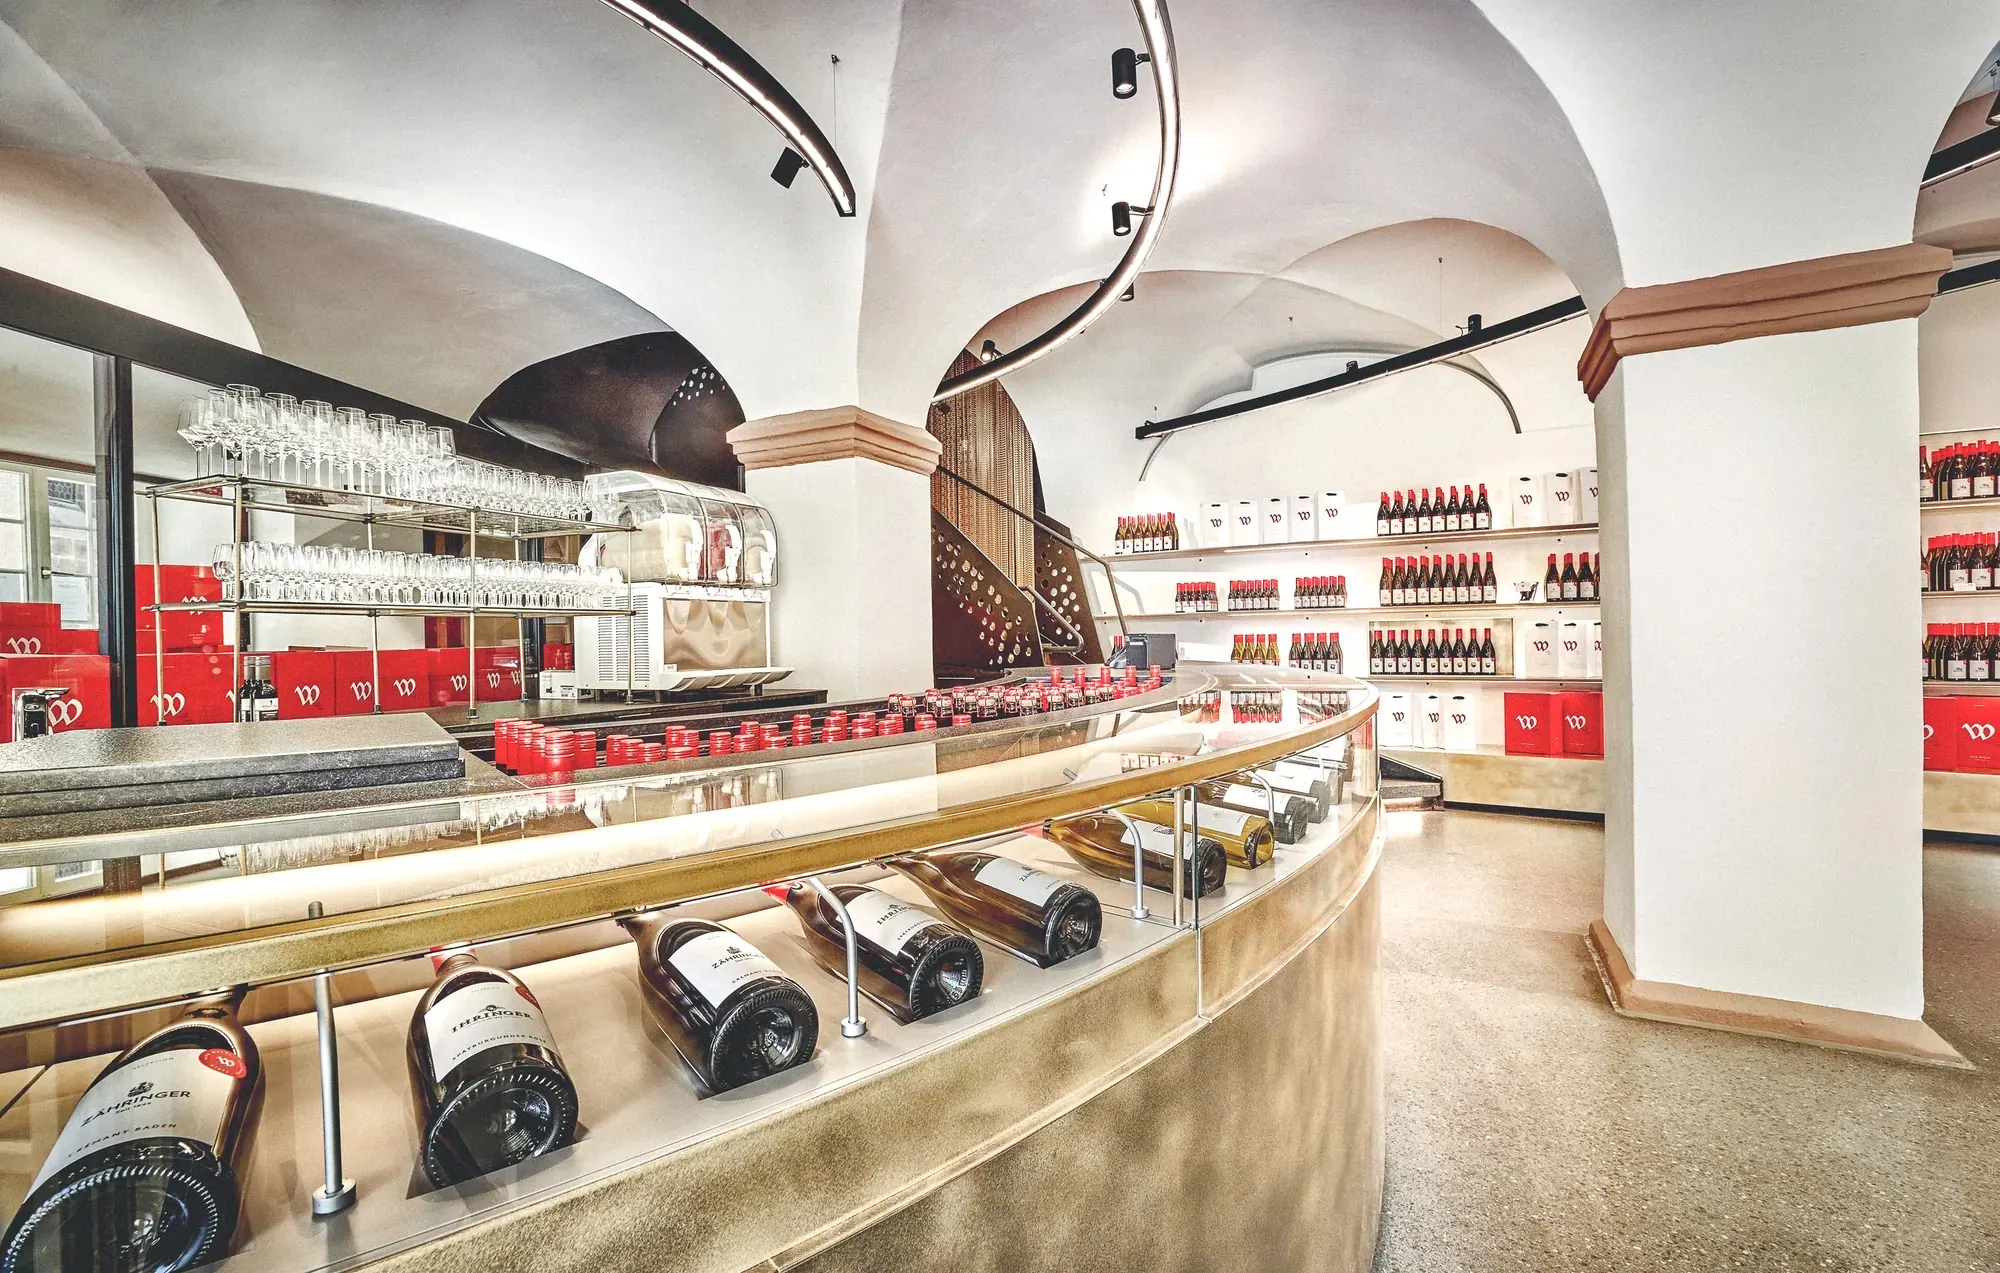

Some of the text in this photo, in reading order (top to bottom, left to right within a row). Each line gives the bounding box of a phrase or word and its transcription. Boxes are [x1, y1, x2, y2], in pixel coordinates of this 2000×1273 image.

[452, 1010, 534, 1034] IHRINGER
[80, 1090, 191, 1128] ZÄHRINGER
[135, 1123, 178, 1132] BADEN
